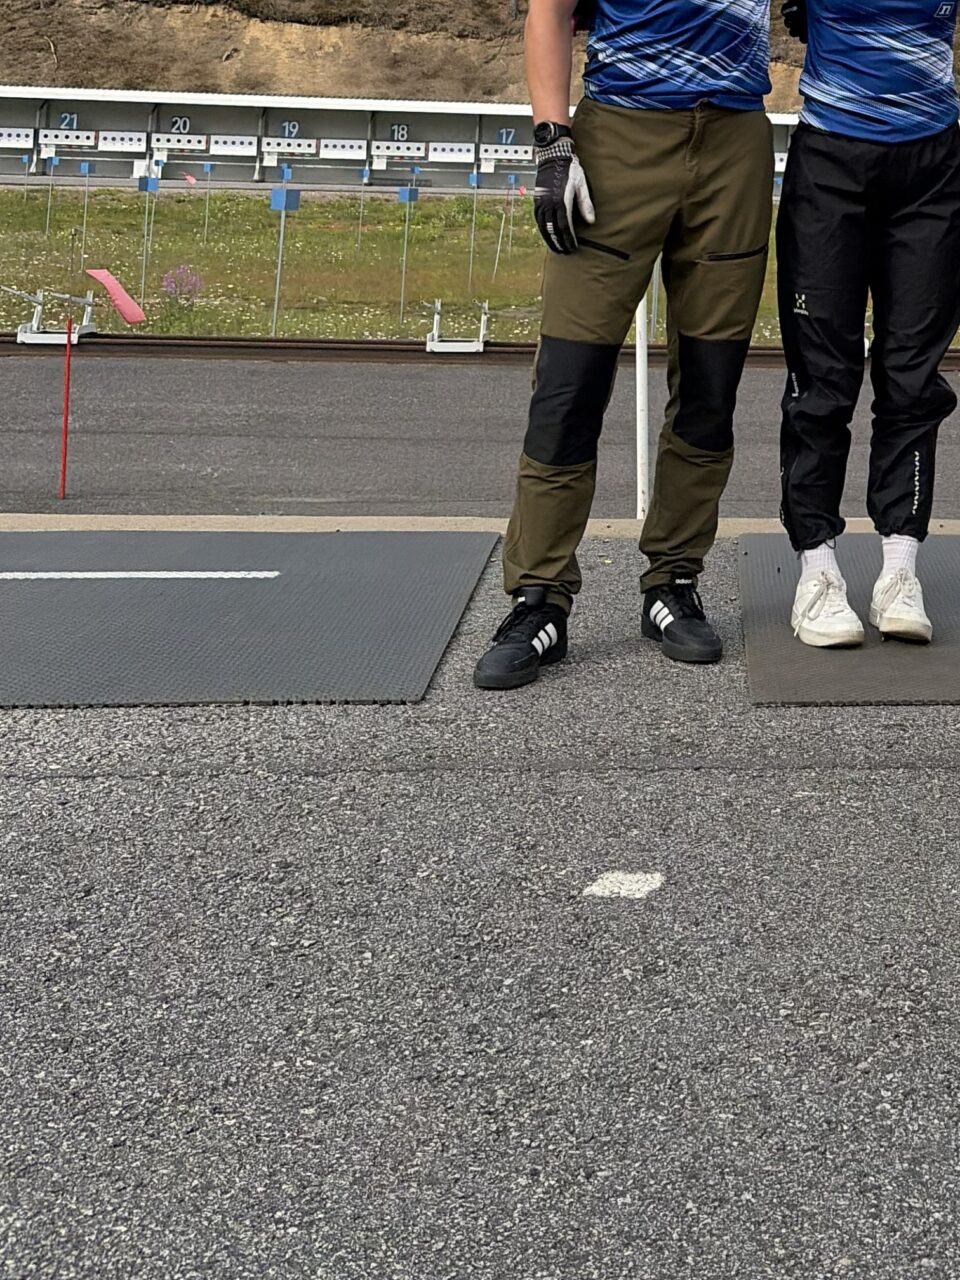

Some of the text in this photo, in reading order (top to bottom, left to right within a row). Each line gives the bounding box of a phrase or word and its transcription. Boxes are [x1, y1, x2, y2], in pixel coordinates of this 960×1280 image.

[60, 113, 78, 130] 21
[171, 117, 190, 134] 20
[282, 121, 299, 138] 19
[391, 124, 408, 141] 18
[500, 128, 516, 144] 17
